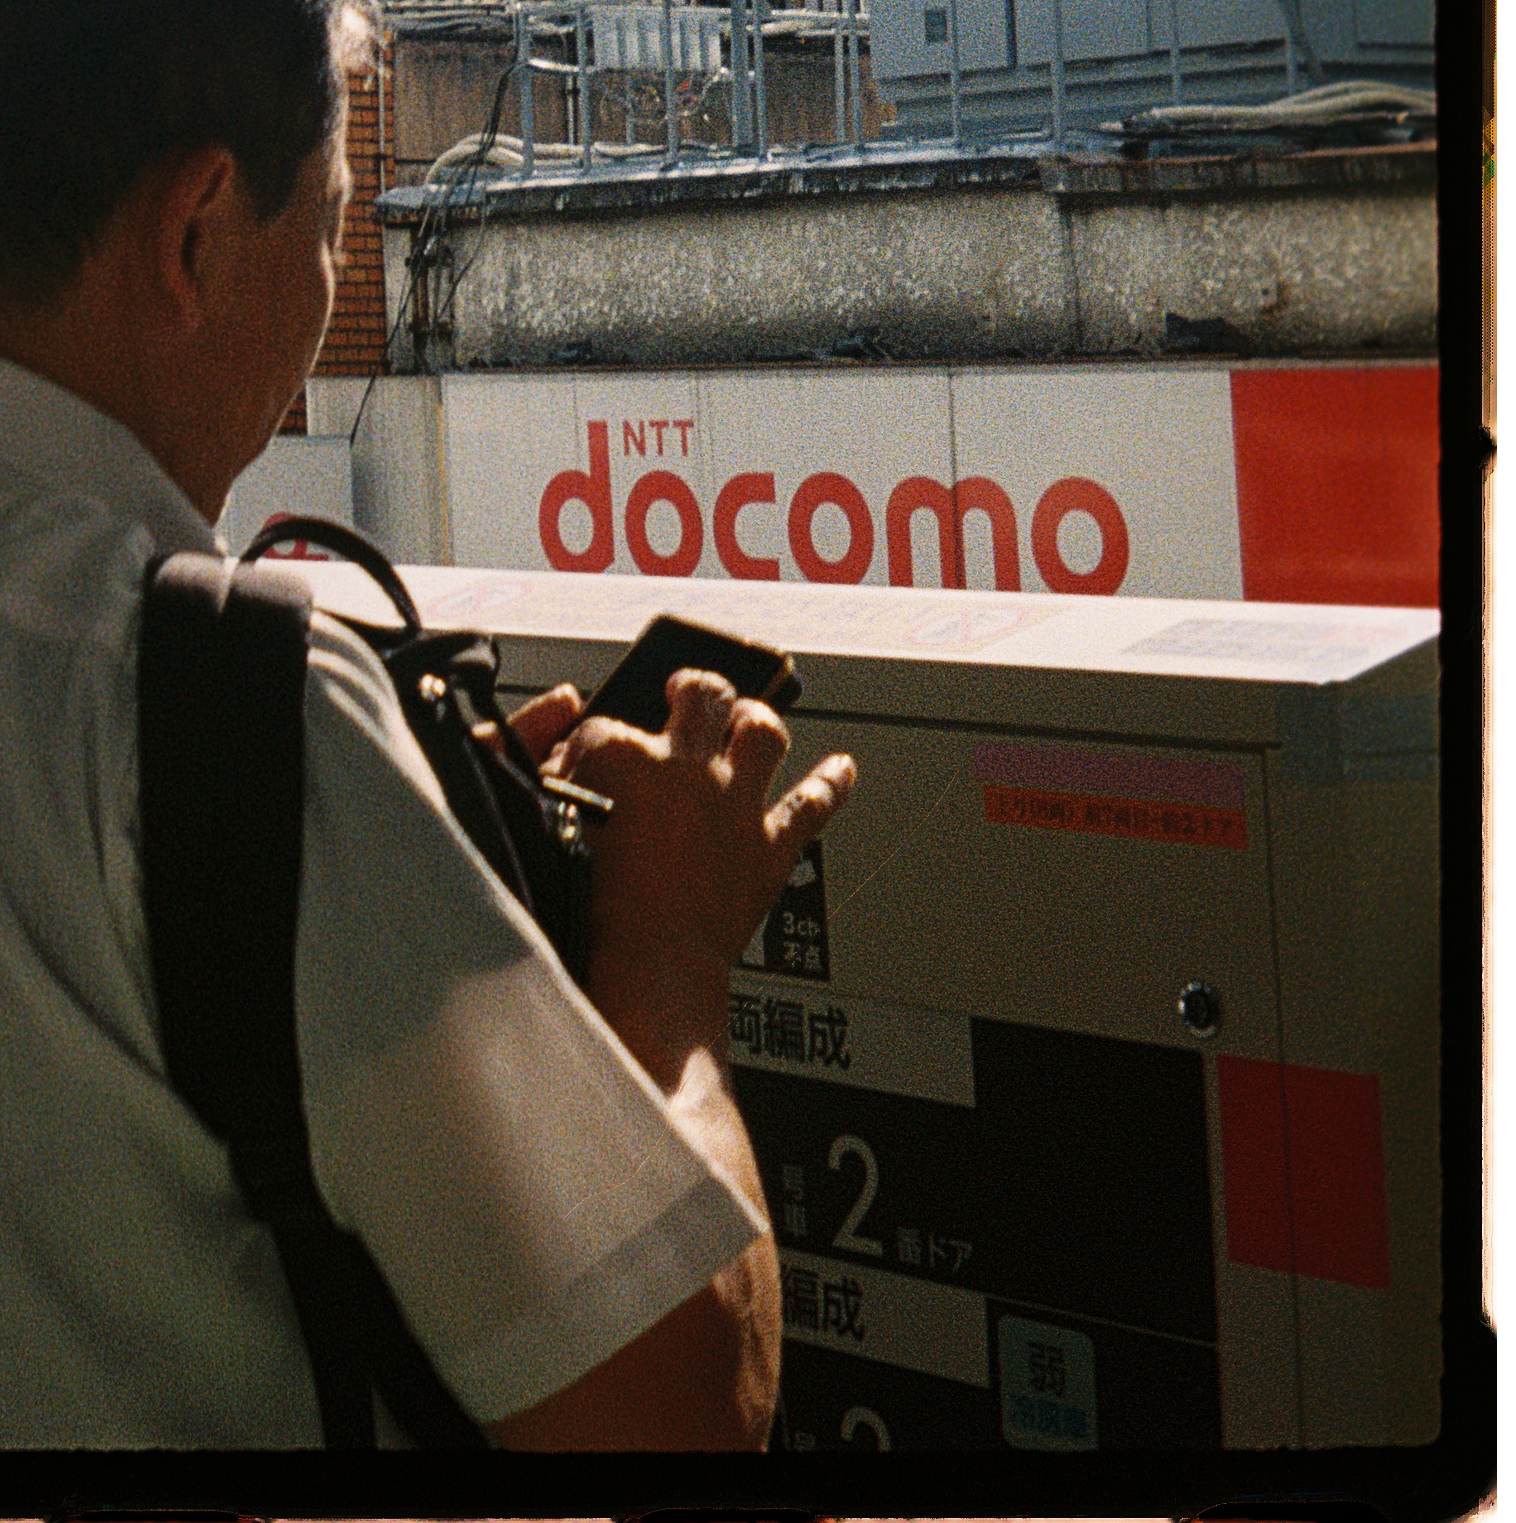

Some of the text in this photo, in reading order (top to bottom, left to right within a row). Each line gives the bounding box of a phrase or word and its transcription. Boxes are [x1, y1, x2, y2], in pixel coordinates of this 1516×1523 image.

[623, 419, 695, 458] NTT
[539, 419, 1130, 598] docomo
[828, 1133, 884, 1257] 2
